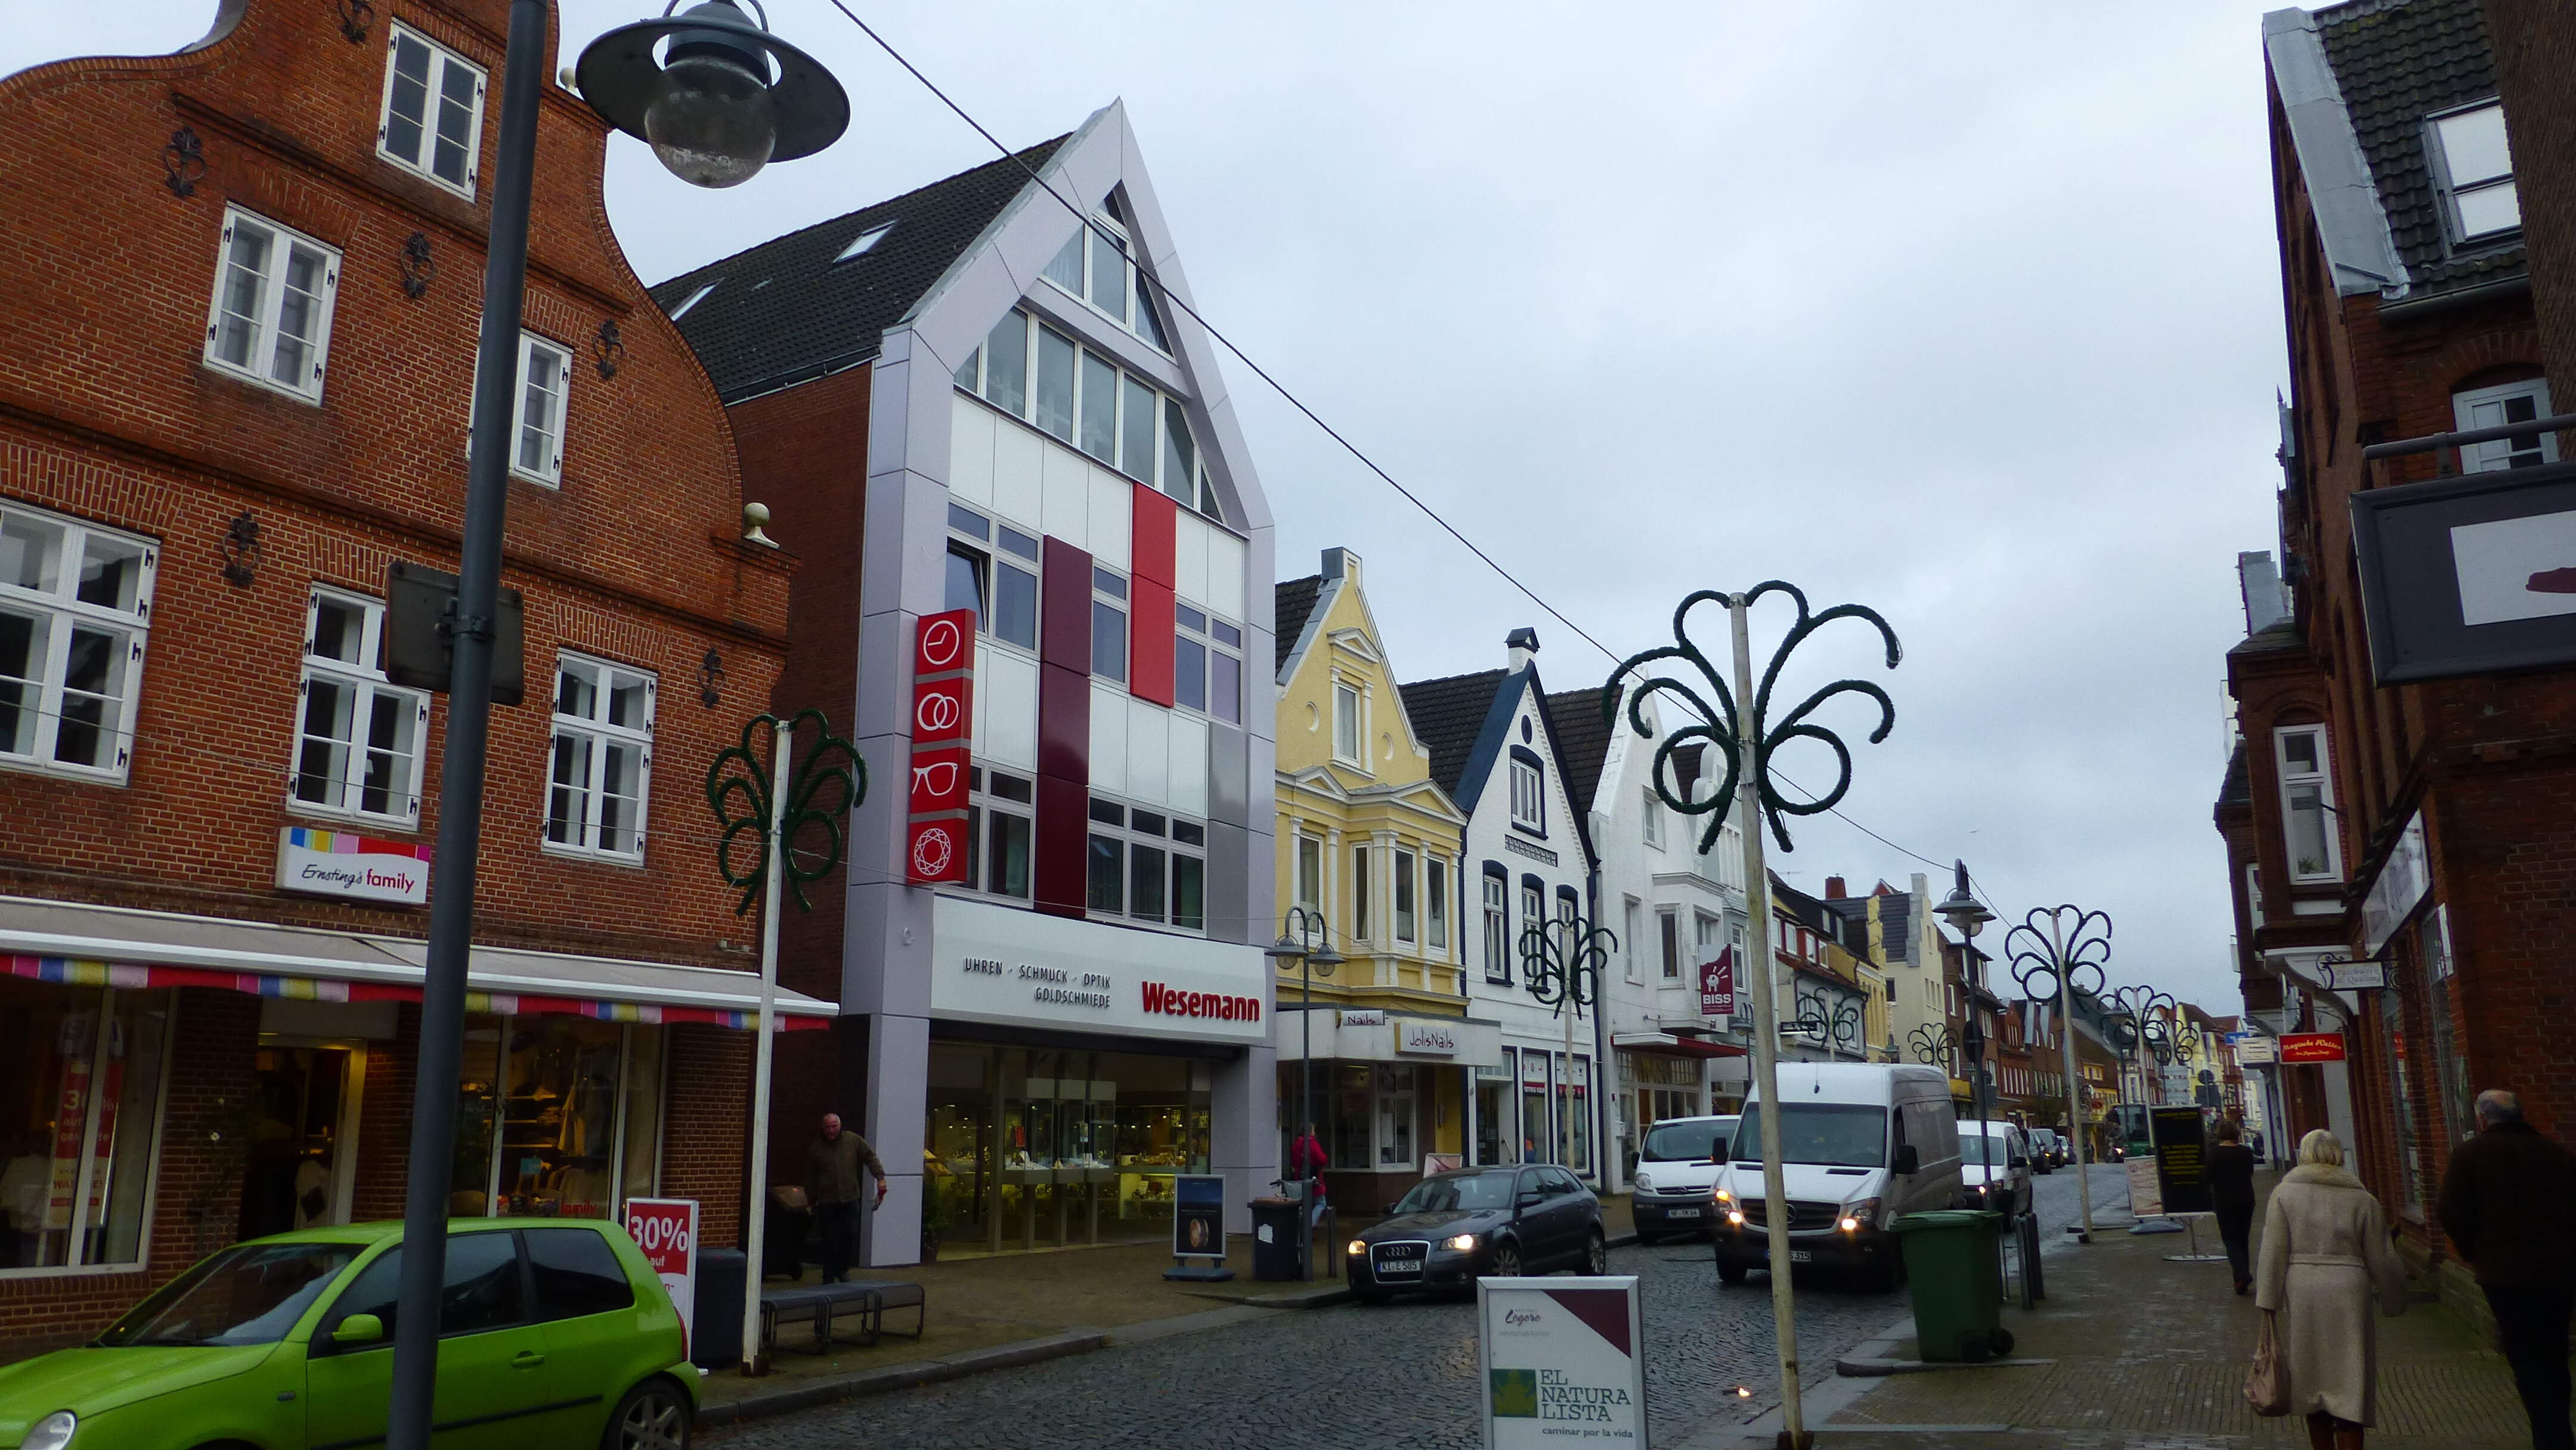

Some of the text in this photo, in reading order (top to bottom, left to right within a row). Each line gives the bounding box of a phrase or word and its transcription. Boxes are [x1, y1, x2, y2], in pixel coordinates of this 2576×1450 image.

[366, 868, 415, 894] family
[964, 958, 1111, 989] UHREN SCHMUCK OPTIK
[1035, 987, 1111, 1008] GOLDSCHMIEDE
[1141, 980, 1260, 1022] Wesemann
[1702, 993, 1732, 1004] BISS
[1348, 1013, 1376, 1025] Nails
[630, 1215, 689, 1252] 30%
[650, 1255, 665, 1267] auf
[1795, 1252, 1810, 1260] 315
[1402, 1261, 1417, 1271] 585
[1540, 1369, 1568, 1385] EL
[1540, 1387, 1631, 1405] NATURA
[1541, 1403, 1613, 1422] LISTA
[1542, 1427, 1633, 1438] caminar por la vida
